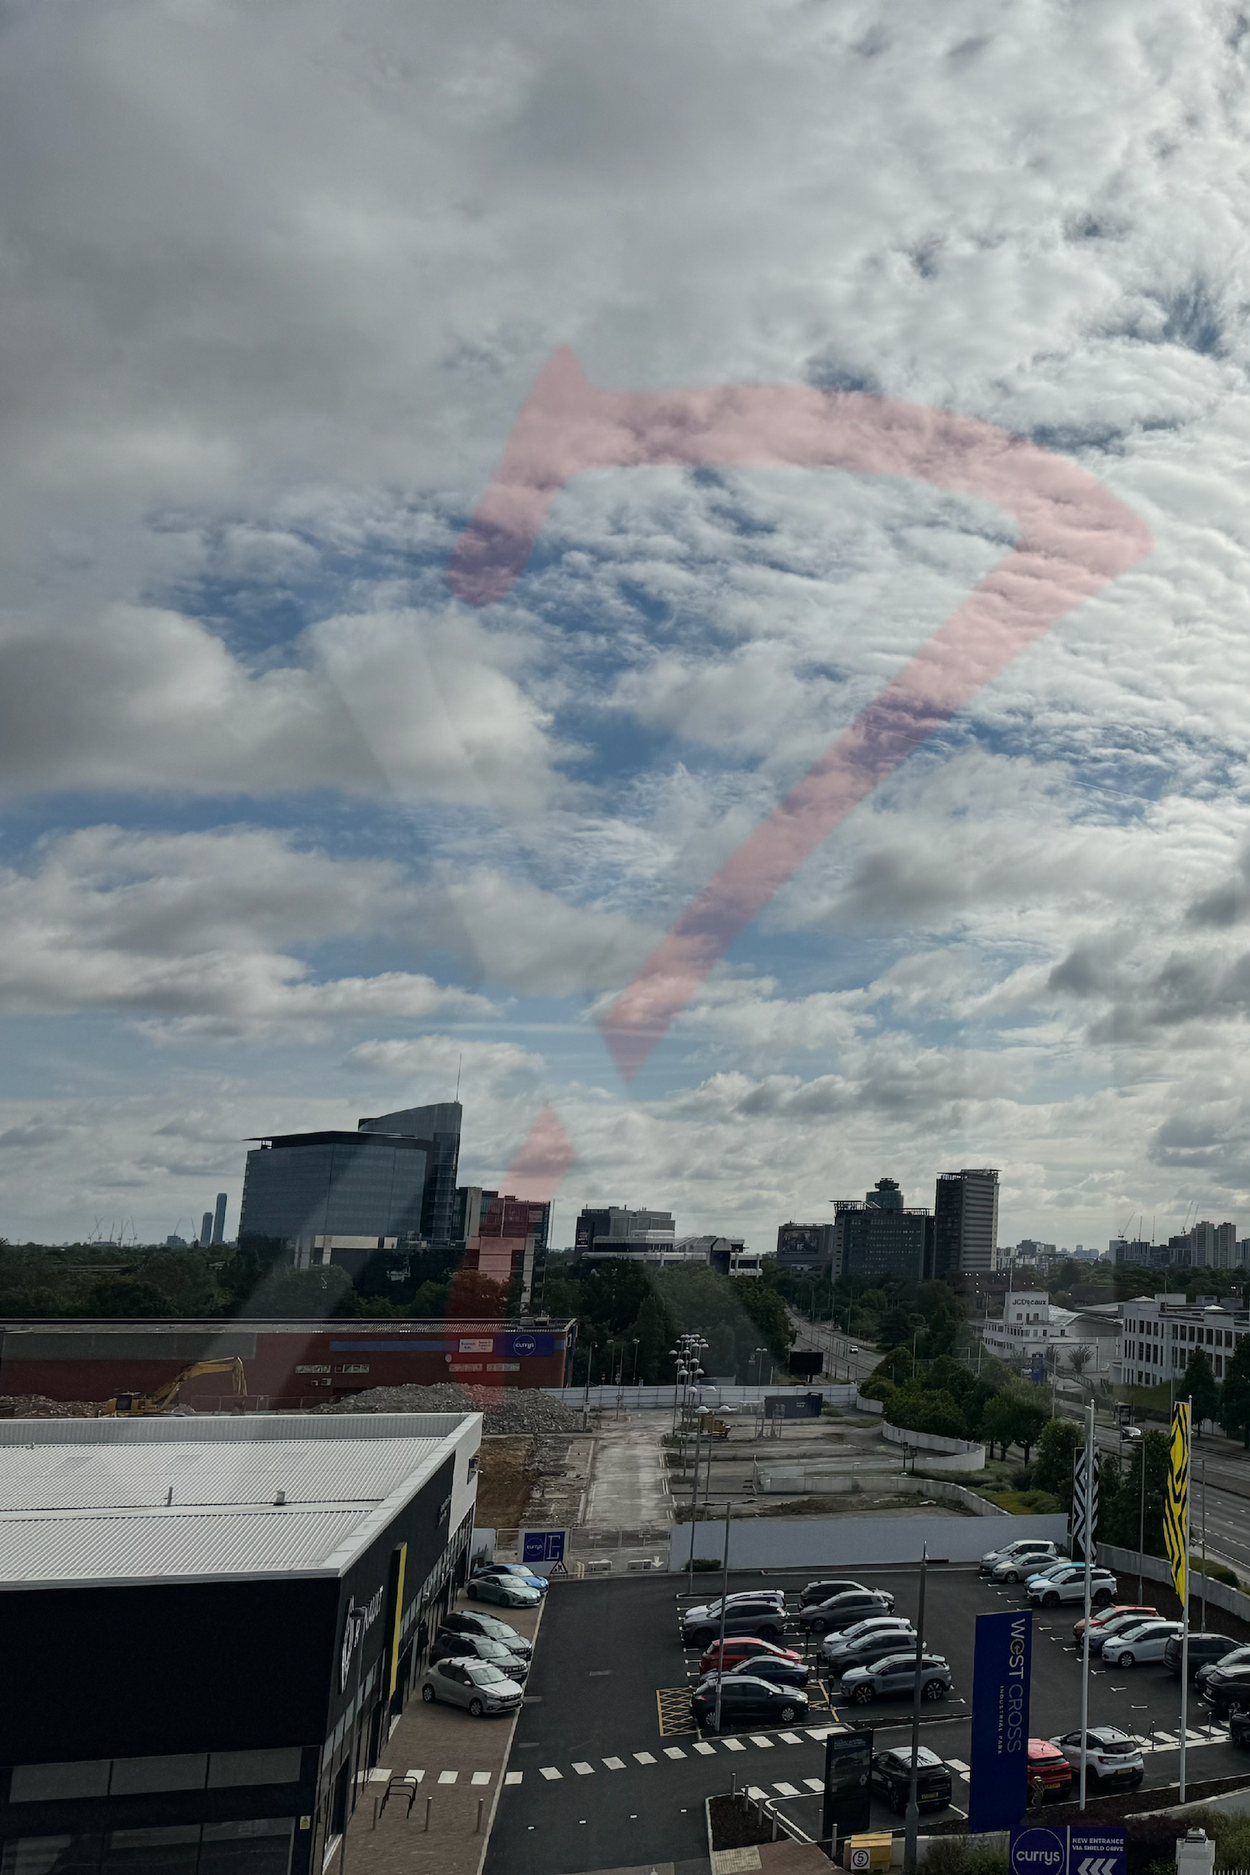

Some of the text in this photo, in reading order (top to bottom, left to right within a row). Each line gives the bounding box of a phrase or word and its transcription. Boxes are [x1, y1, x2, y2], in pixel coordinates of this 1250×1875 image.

[1012, 1298, 1047, 1306] JCDecaux
[514, 1341, 535, 1350] currys
[997, 1685, 1005, 1732] INDUSTRIAL
[1006, 1683, 1024, 1754] CROSS
[857, 1852, 864, 1862] 5
[1015, 1850, 1061, 1866] currys
